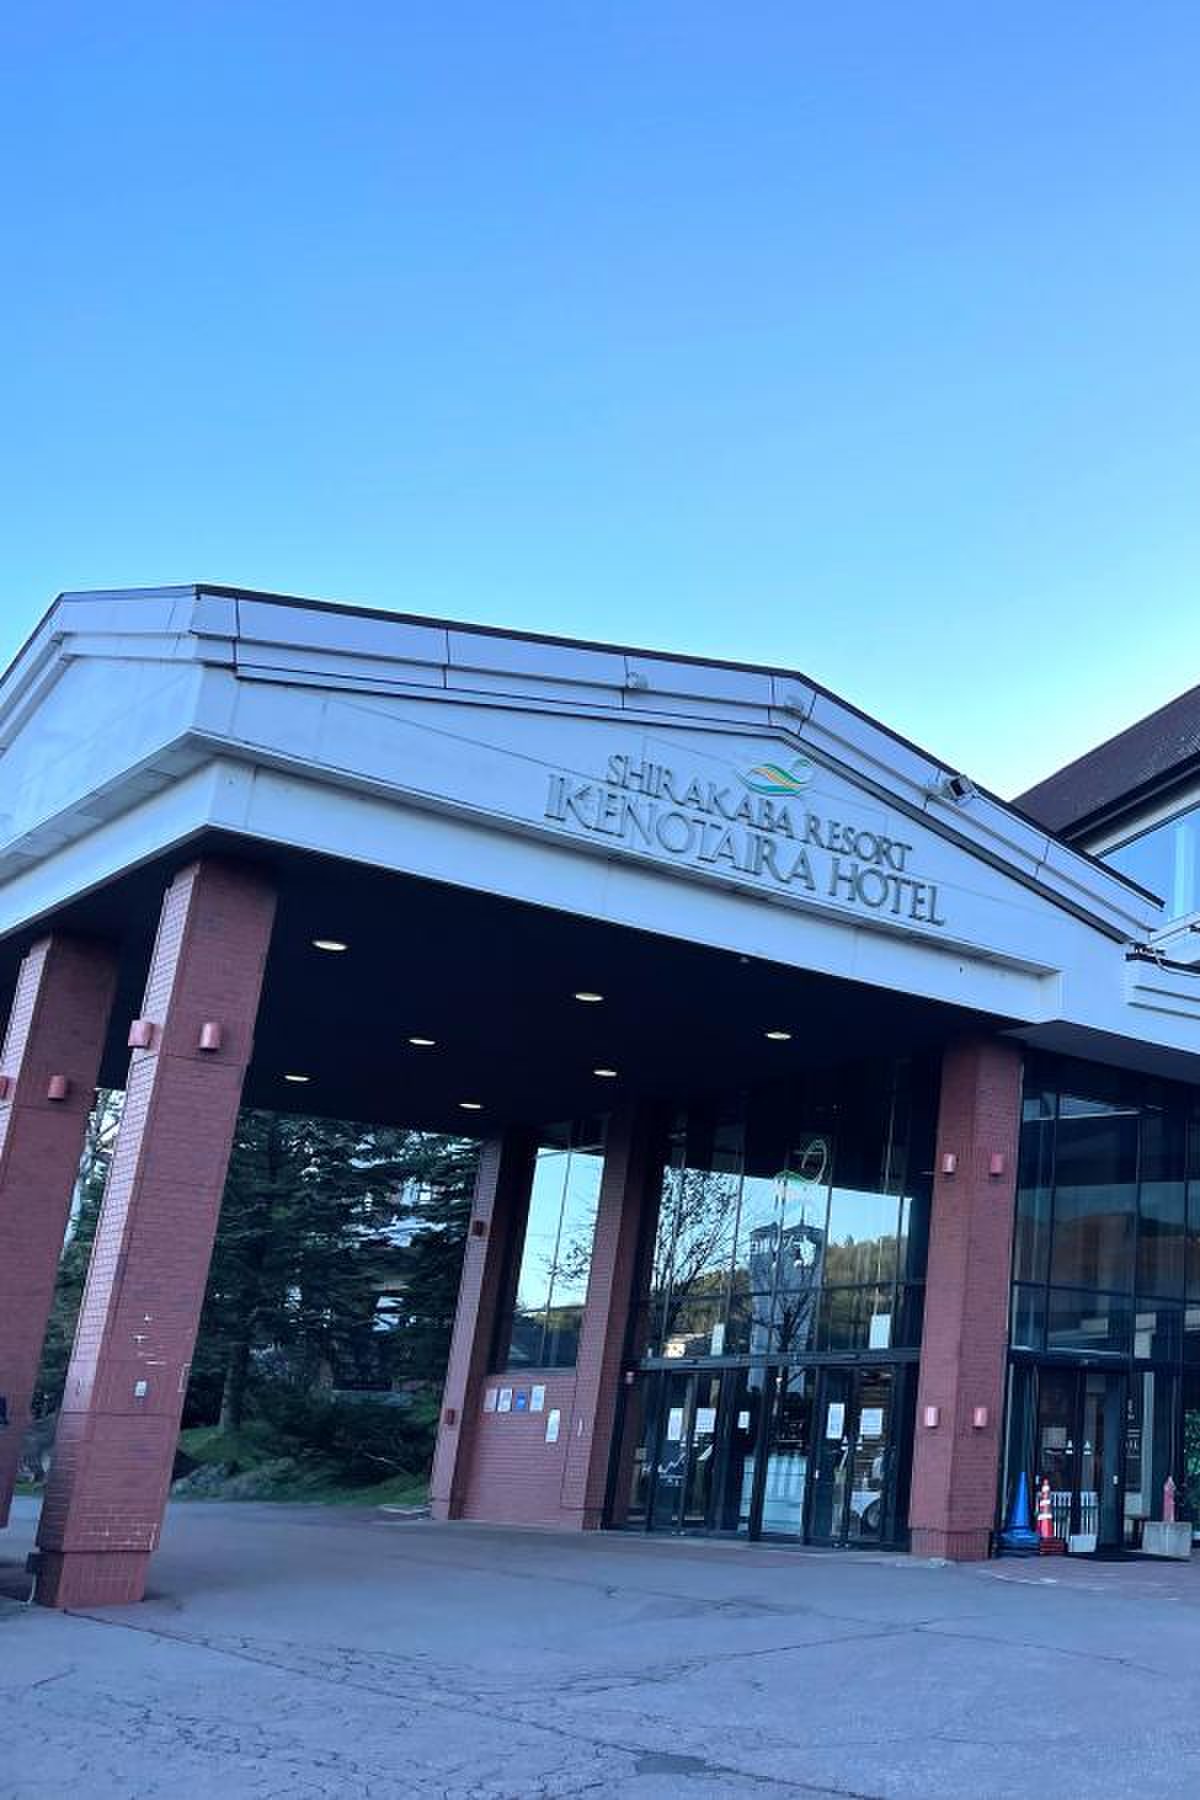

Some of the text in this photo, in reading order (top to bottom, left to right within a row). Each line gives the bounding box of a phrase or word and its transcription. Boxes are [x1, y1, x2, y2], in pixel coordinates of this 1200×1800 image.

[544, 774, 945, 927] IKENOTAIRA HOTEL
[606, 754, 912, 872] SHIRAKABA RESORT
